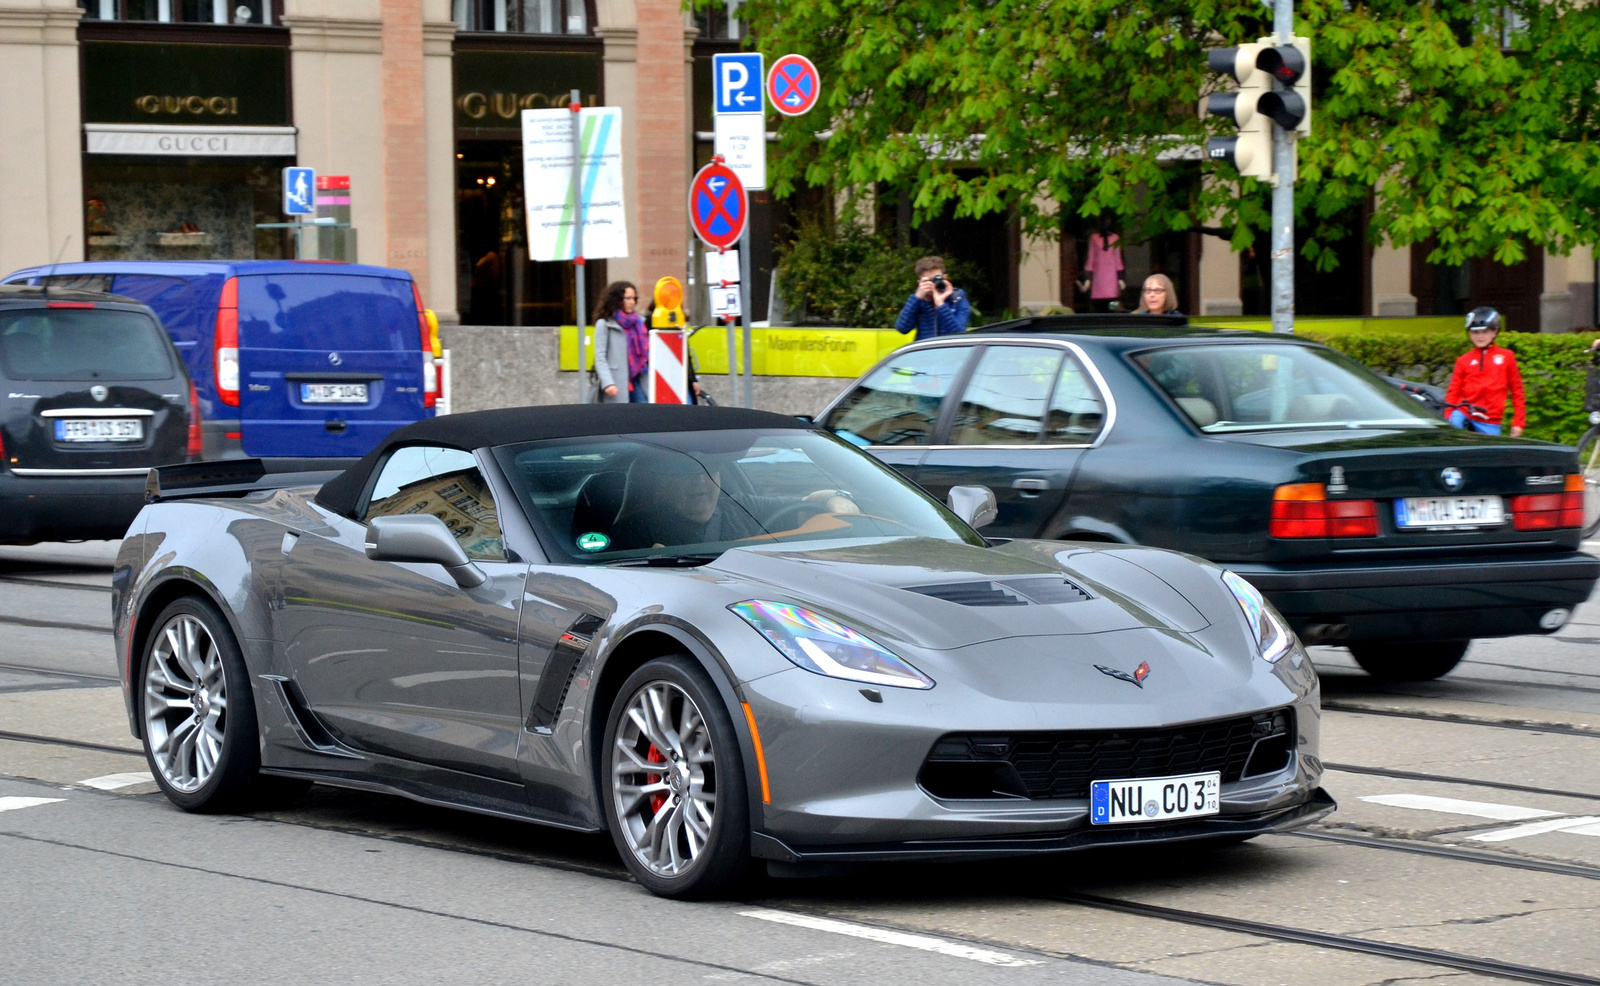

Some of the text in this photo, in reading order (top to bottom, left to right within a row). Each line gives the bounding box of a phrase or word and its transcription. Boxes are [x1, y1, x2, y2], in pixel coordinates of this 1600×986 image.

[722, 62, 749, 107] P
[139, 94, 238, 116] GUCCI
[158, 136, 229, 152] GUCCI
[768, 335, 857, 352] MaximiliansForum
[1098, 806, 1105, 816] D
[1111, 786, 1142, 818] NU
[1194, 780, 1206, 810] 3
